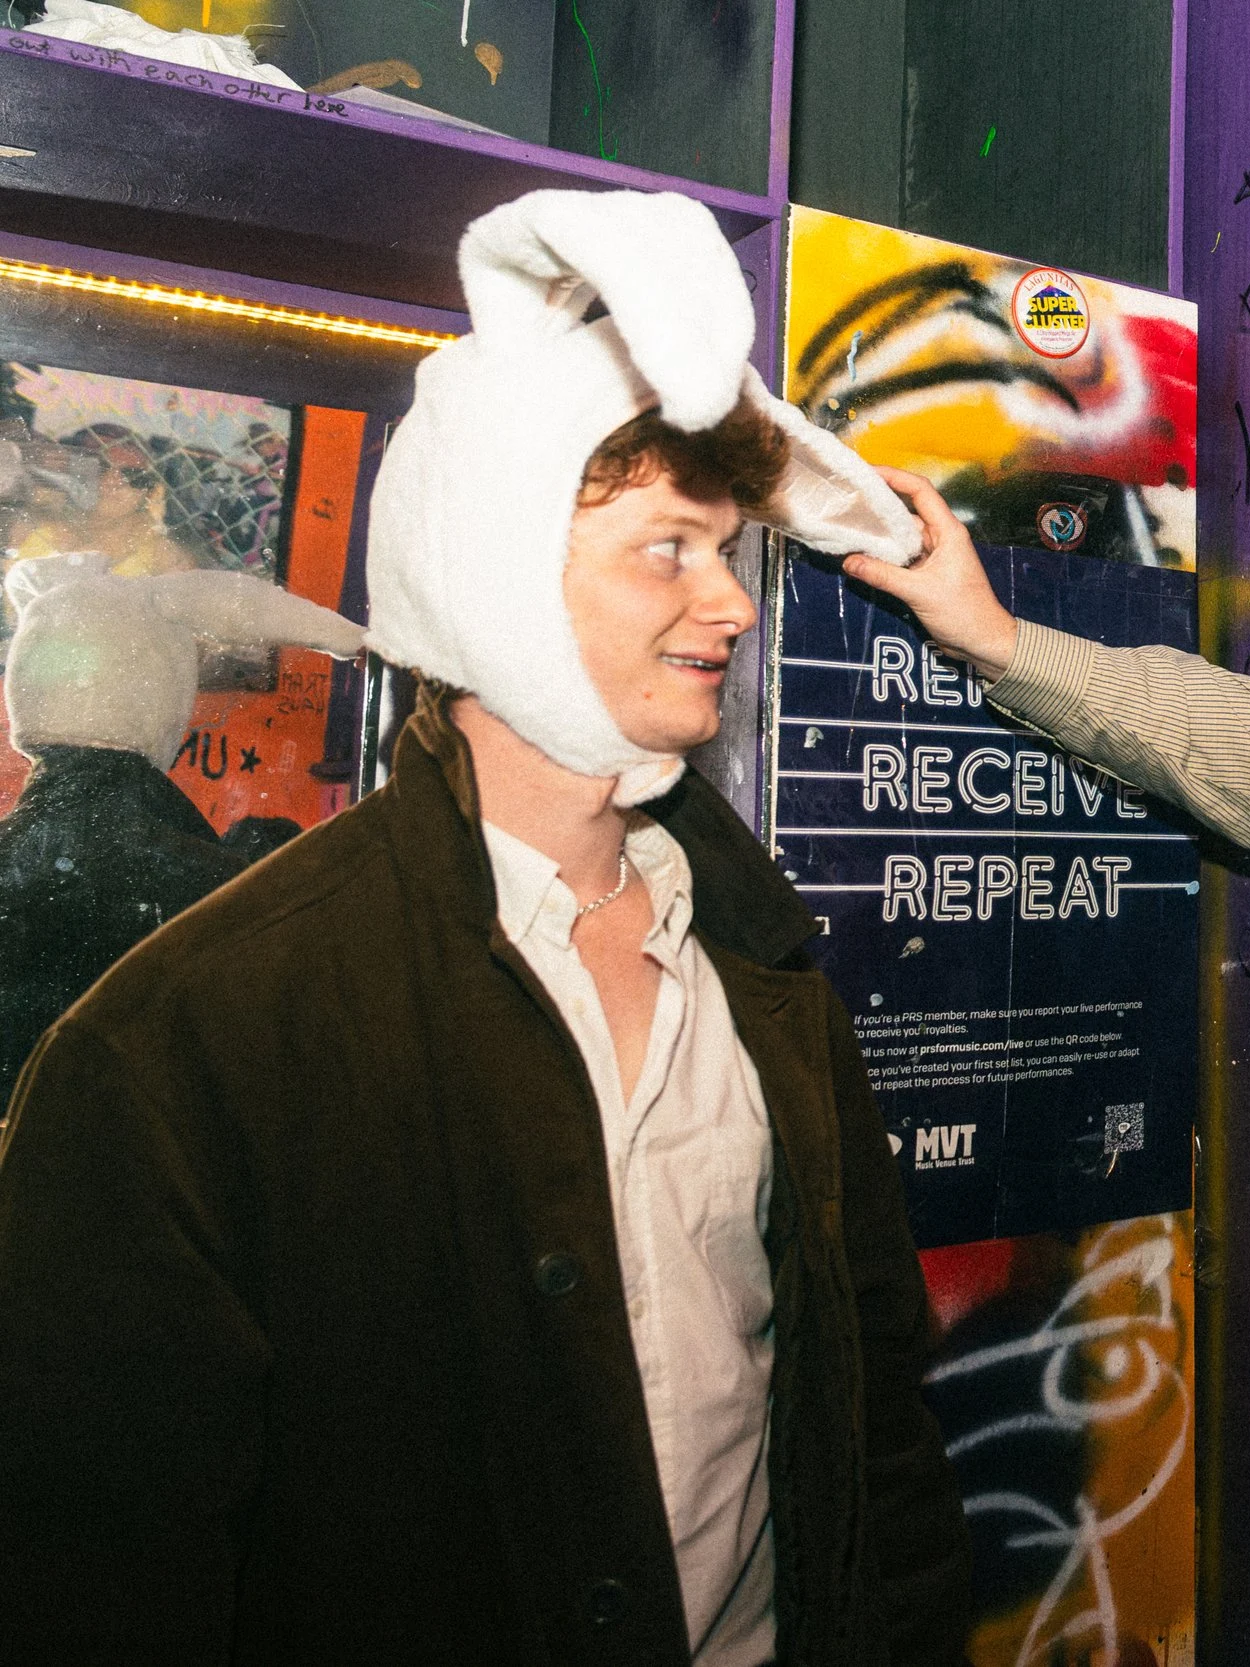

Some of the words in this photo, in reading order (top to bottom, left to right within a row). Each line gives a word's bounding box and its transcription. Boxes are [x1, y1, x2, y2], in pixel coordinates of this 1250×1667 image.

[70, 46, 131, 72] with
[144, 65, 214, 90] each
[304, 93, 350, 118] here
[1023, 272, 1076, 292] LAGUNITAS
[1029, 297, 1079, 313] SUPER
[1023, 314, 1086, 330] CLUSTER
[882, 855, 1132, 922] REPEAT
[854, 1015, 863, 1025] If
[863, 1014, 893, 1026] you're
[894, 1015, 901, 1024] a
[902, 1012, 924, 1022] PRS
[924, 1009, 969, 1021] member,
[970, 1009, 997, 1019] make
[998, 1008, 1017, 1019] sure
[1018, 1009, 1034, 1019] you
[1035, 1006, 1060, 1017] report
[1061, 1005, 1080, 1015] your
[1080, 1003, 1095, 1013] live
[1095, 1001, 1143, 1013] performance
[866, 1026, 902, 1038] receive
[925, 1023, 969, 1036] royalties.
[873, 1047, 885, 1057] us
[886, 1046, 907, 1057] now
[908, 1045, 919, 1056] at
[920, 1037, 1025, 1056] prsformusic.com/live
[1025, 1040, 1034, 1049] or
[1034, 1038, 1050, 1047] use
[1050, 1035, 1065, 1046] the
[1065, 1034, 1079, 1045] QR
[1079, 1033, 1099, 1044] code
[1100, 1031, 1122, 1043] below
[881, 1064, 912, 1078] you've
[912, 1061, 950, 1073] created
[950, 1061, 974, 1073] your
[974, 1058, 994, 1070] first
[995, 1057, 1011, 1068] set
[1011, 1057, 1025, 1068] list,
[1026, 1056, 1041, 1068] you
[1042, 1054, 1059, 1065] can
[1058, 1051, 1083, 1063] easily
[1083, 1050, 1109, 1060] re-use
[1109, 1049, 1118, 1058] or
[1118, 1046, 1141, 1058] adapt
[883, 1078, 913, 1092] repeat
[914, 1076, 931, 1088] the
[931, 1075, 972, 1088] process
[972, 1073, 986, 1084] for
[987, 1071, 1015, 1083] future
[1015, 1067, 1075, 1082] performances.
[915, 1124, 977, 1162] MVT
[915, 1160, 934, 1171] Music
[935, 1158, 957, 1169] Venue
[958, 1157, 975, 1166] Trust
